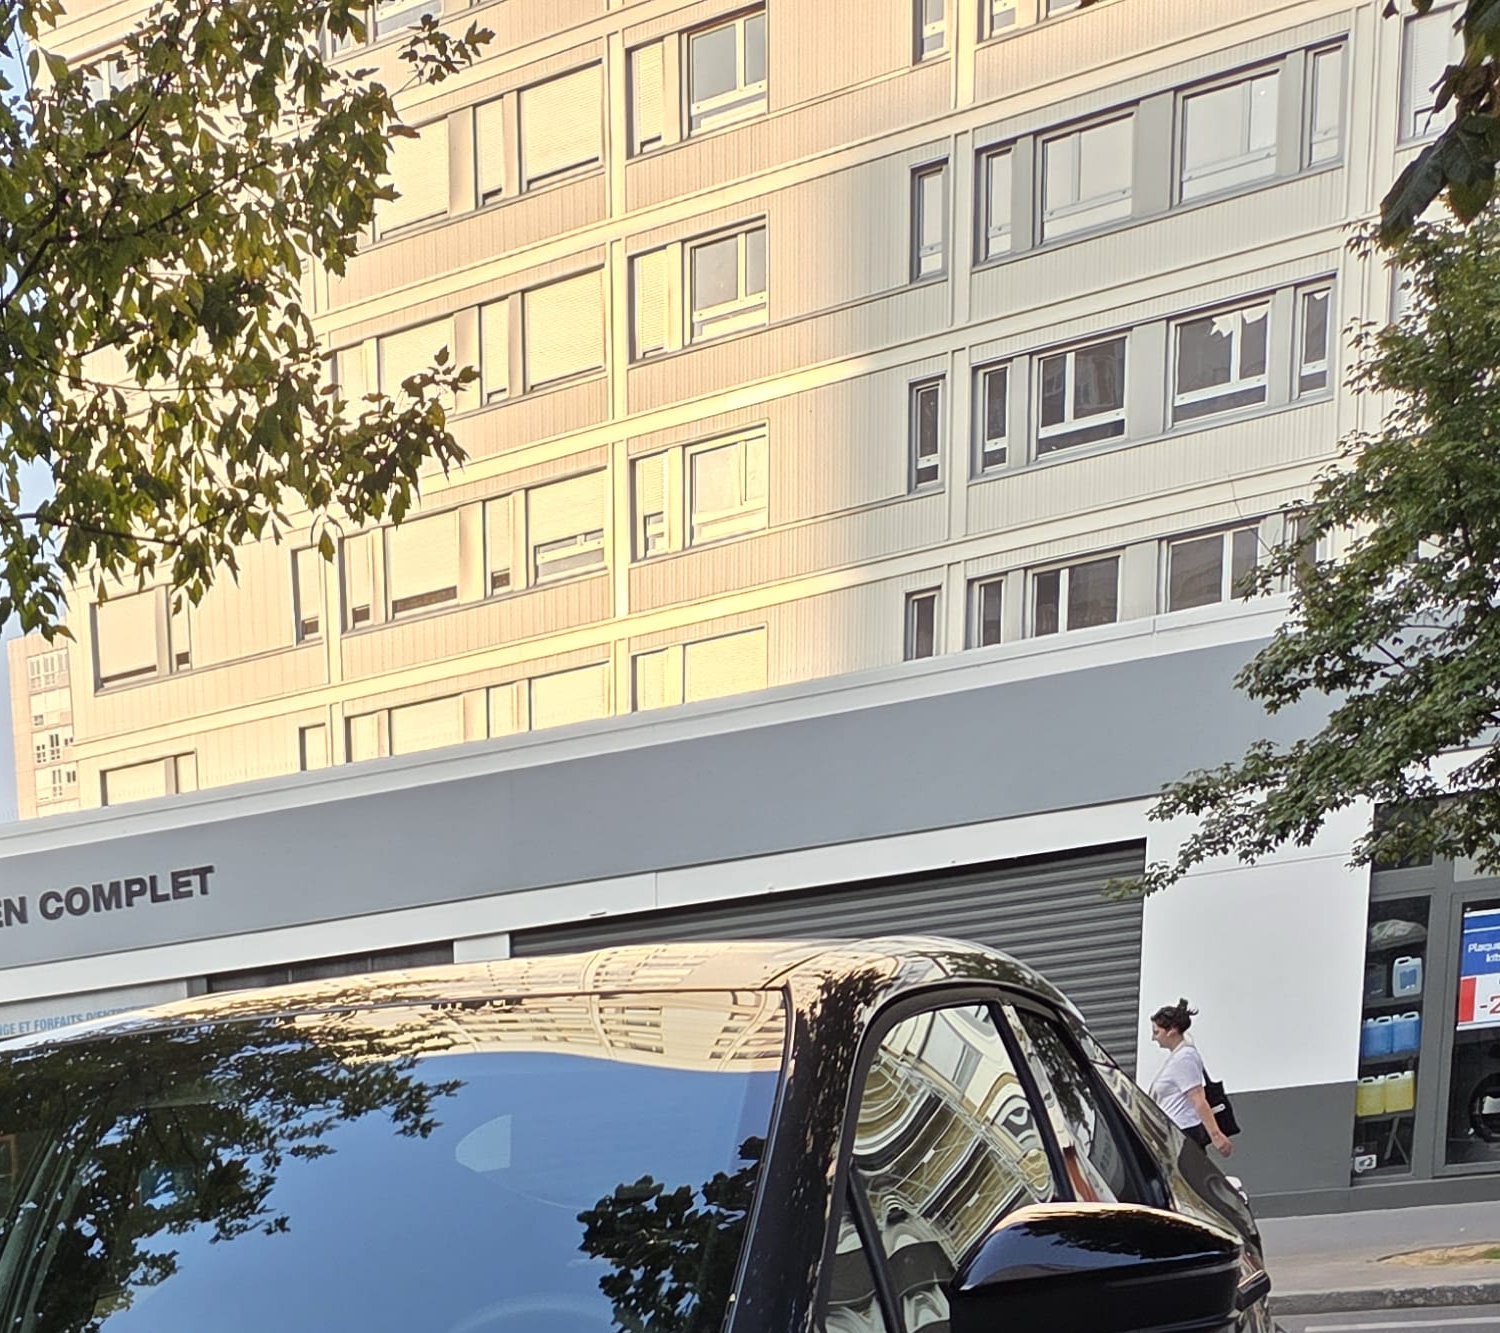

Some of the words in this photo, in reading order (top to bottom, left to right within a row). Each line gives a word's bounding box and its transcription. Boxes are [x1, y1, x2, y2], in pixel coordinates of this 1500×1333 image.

[39, 865, 215, 921] COMPLET
[19, 1021, 30, 1034] ET
[34, 1014, 83, 1032] FORFAITS
